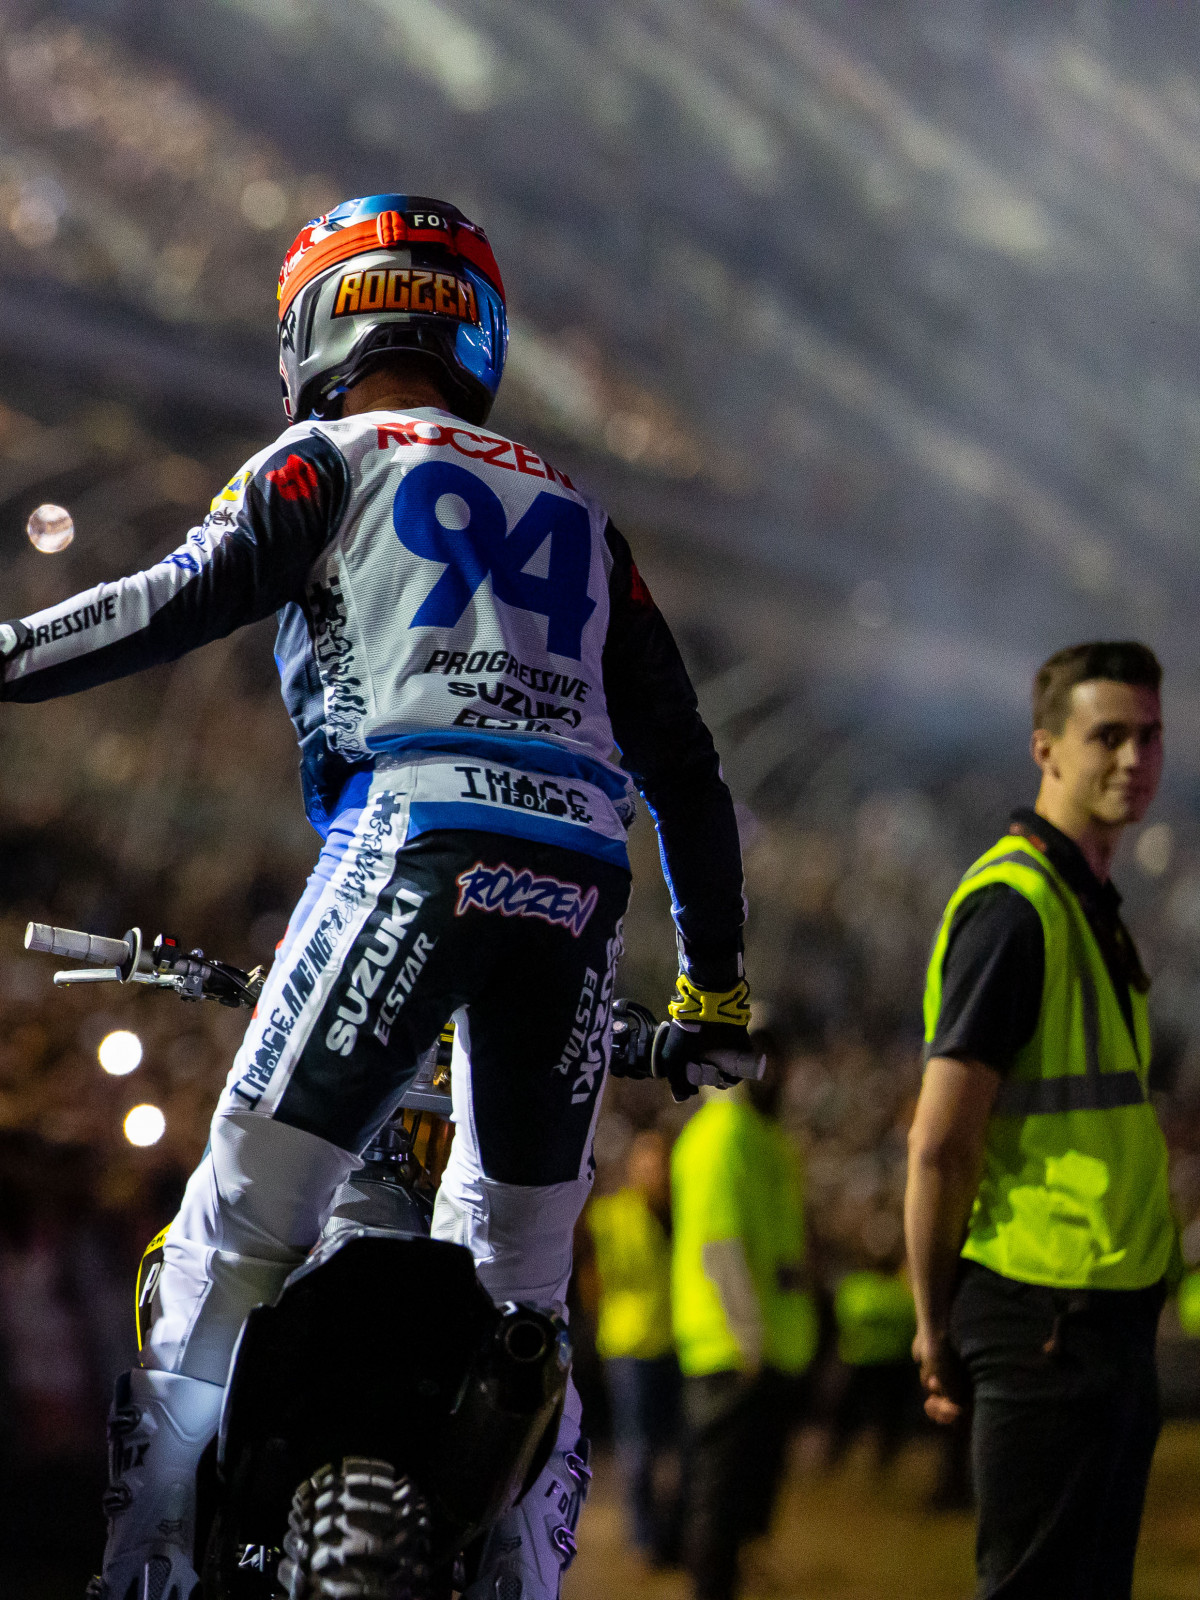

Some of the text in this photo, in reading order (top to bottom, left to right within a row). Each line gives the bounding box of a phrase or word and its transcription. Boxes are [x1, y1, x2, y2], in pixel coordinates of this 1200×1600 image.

[334, 270, 479, 322] ROCZEN
[372, 421, 577, 491] ROCZEN
[392, 461, 597, 661] 94
[423, 650, 590, 703] PROGRESSIVE
[452, 708, 563, 736] ECSTA
[510, 790, 549, 812] FOX
[456, 862, 598, 936] ROCZEN
[326, 887, 424, 1057] SUZUKI
[374, 932, 437, 1047] ECSTAR
[553, 966, 598, 1076] ECSTAR
[262, 1049, 282, 1079] FOX
